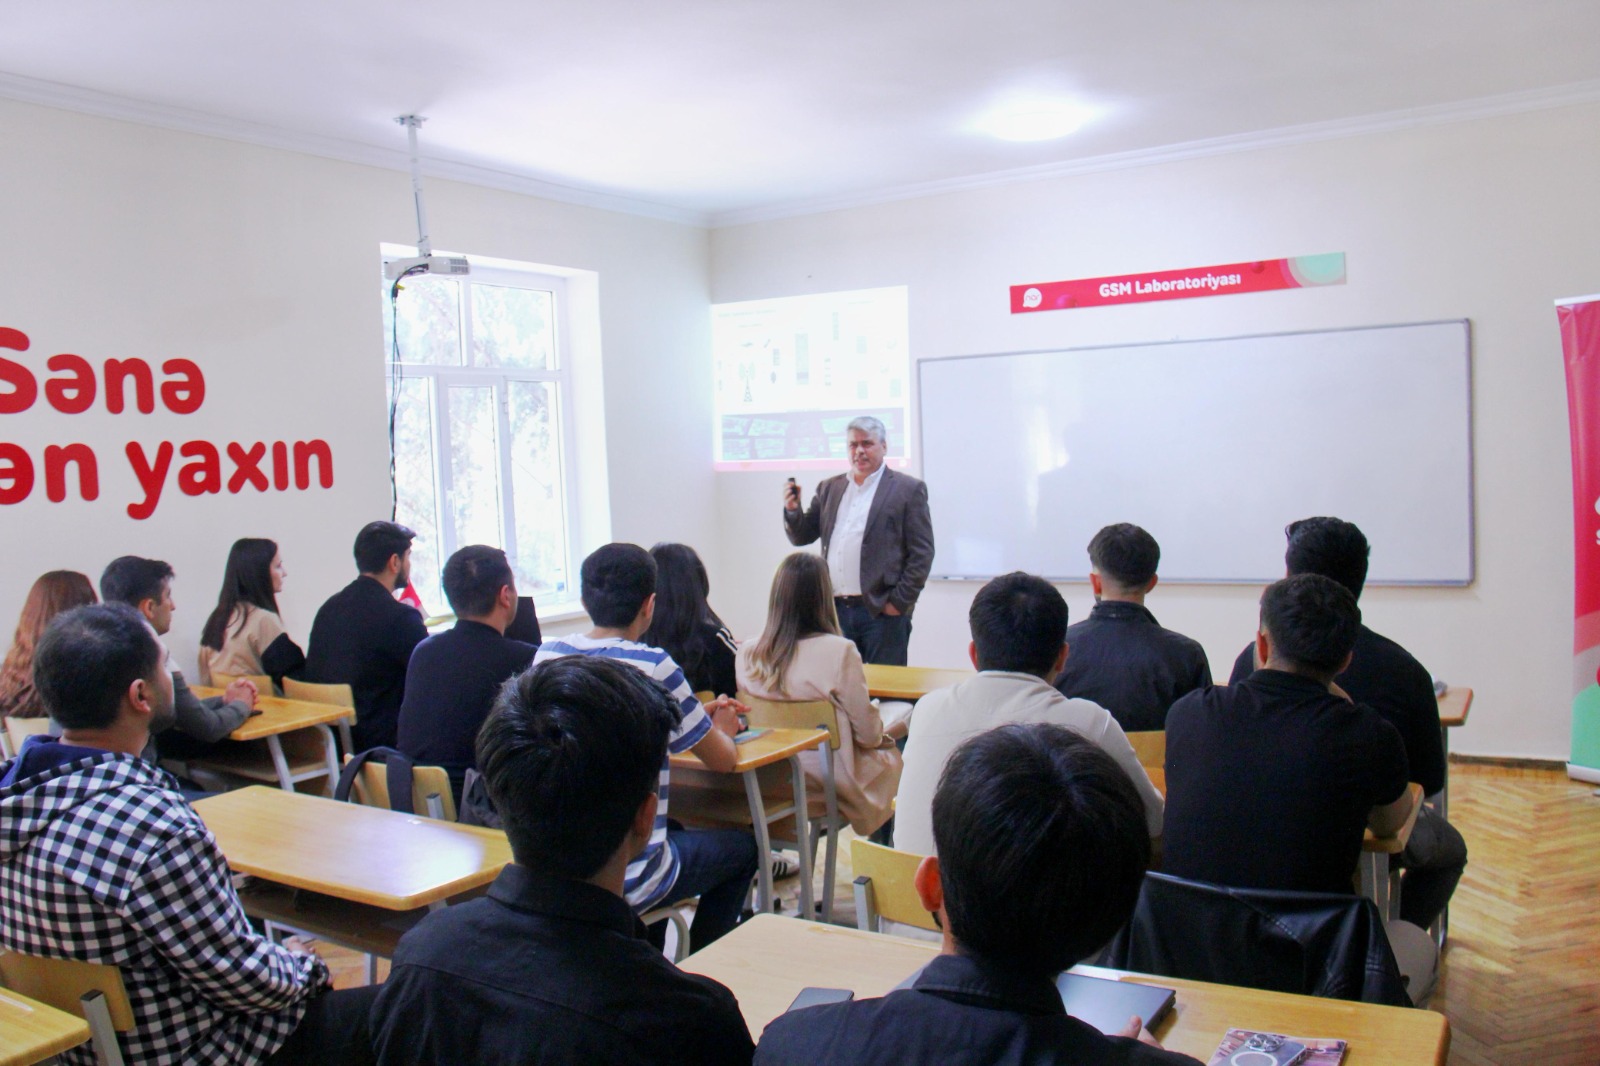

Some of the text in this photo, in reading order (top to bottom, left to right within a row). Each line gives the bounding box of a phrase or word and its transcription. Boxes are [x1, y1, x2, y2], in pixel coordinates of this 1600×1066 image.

[1099, 273, 1241, 298] GSM Laboratoriyası
[0, 326, 206, 415] Sənə
[125, 438, 334, 520] yaxın
